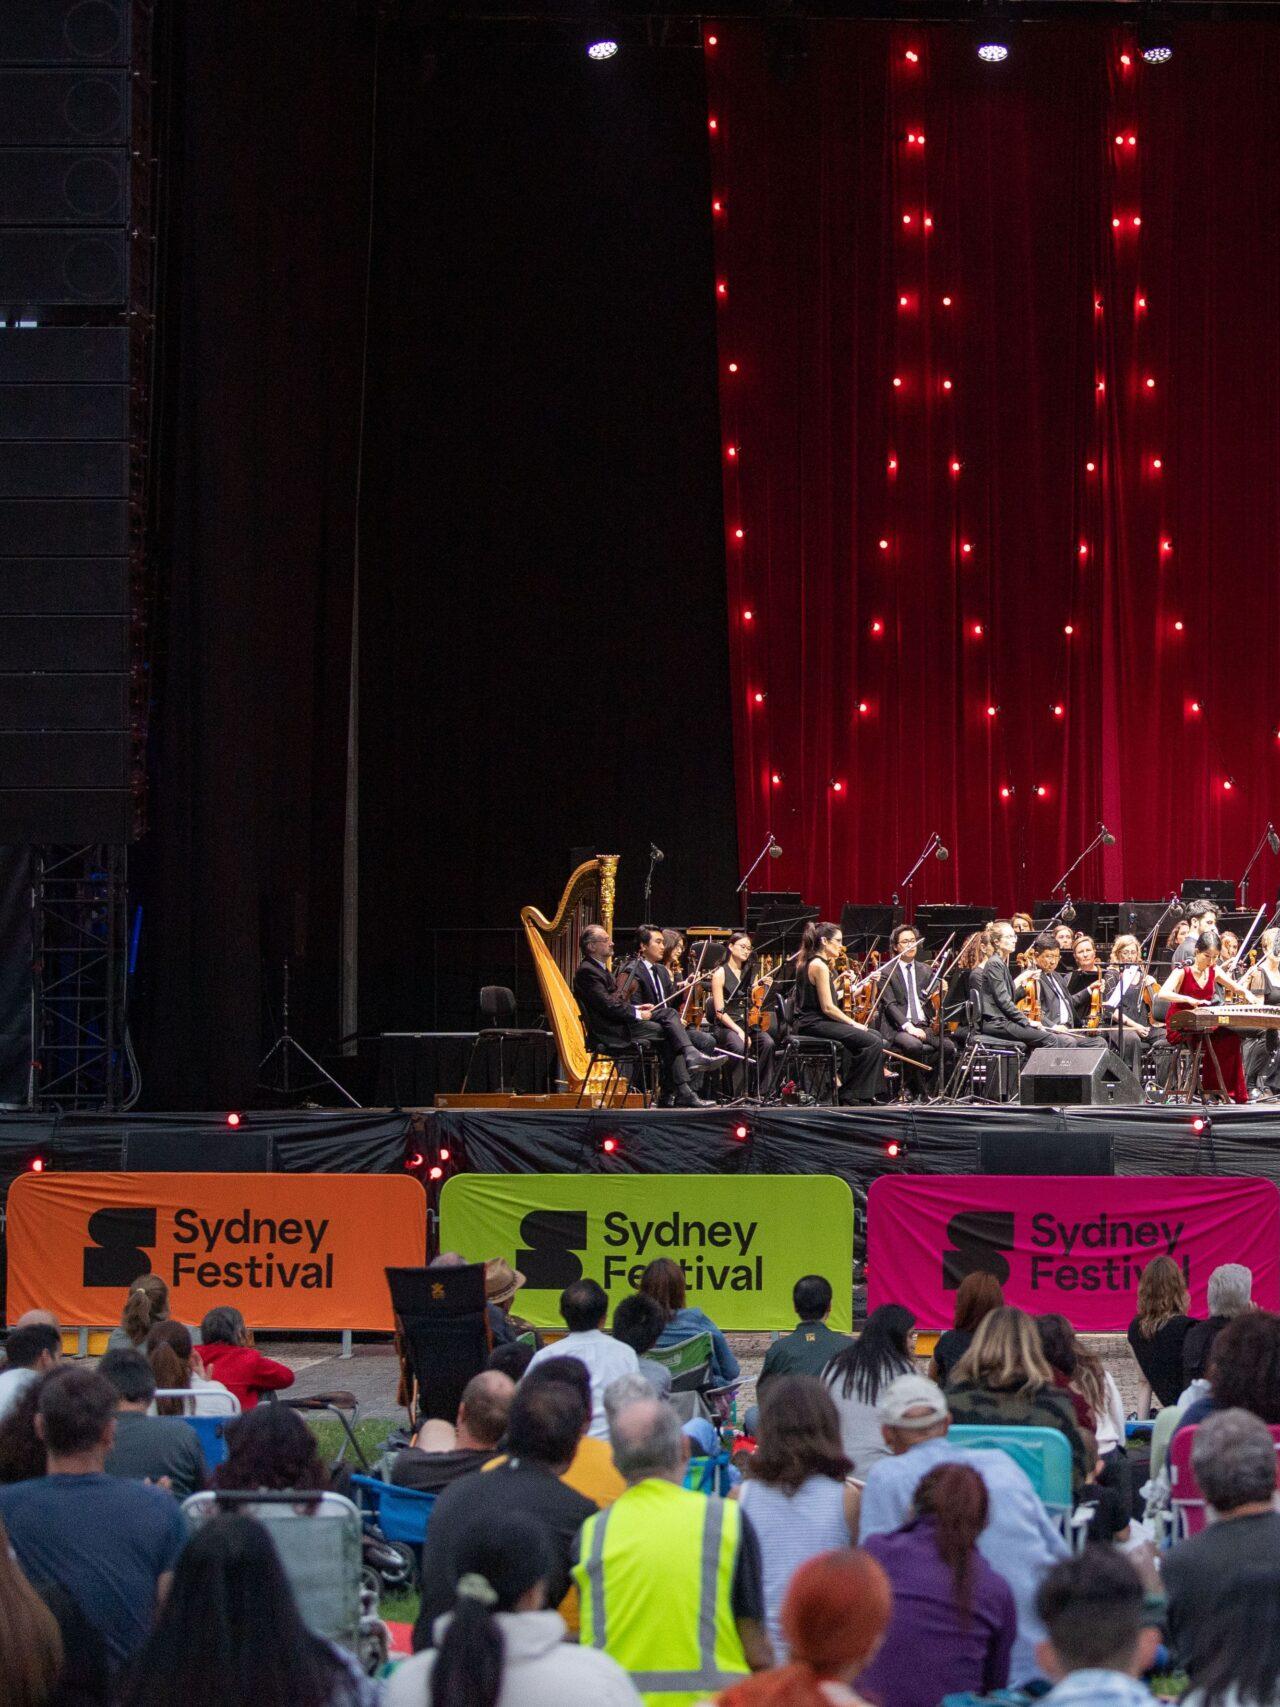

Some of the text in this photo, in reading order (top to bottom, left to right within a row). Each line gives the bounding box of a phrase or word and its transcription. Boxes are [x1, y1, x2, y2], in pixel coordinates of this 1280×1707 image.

[173, 1208, 329, 1253] Sydney
[603, 1211, 758, 1256] Sydney
[1031, 1212, 1184, 1256] Sydney
[173, 1252, 334, 1289] Festival
[604, 1255, 763, 1291] Fetival
